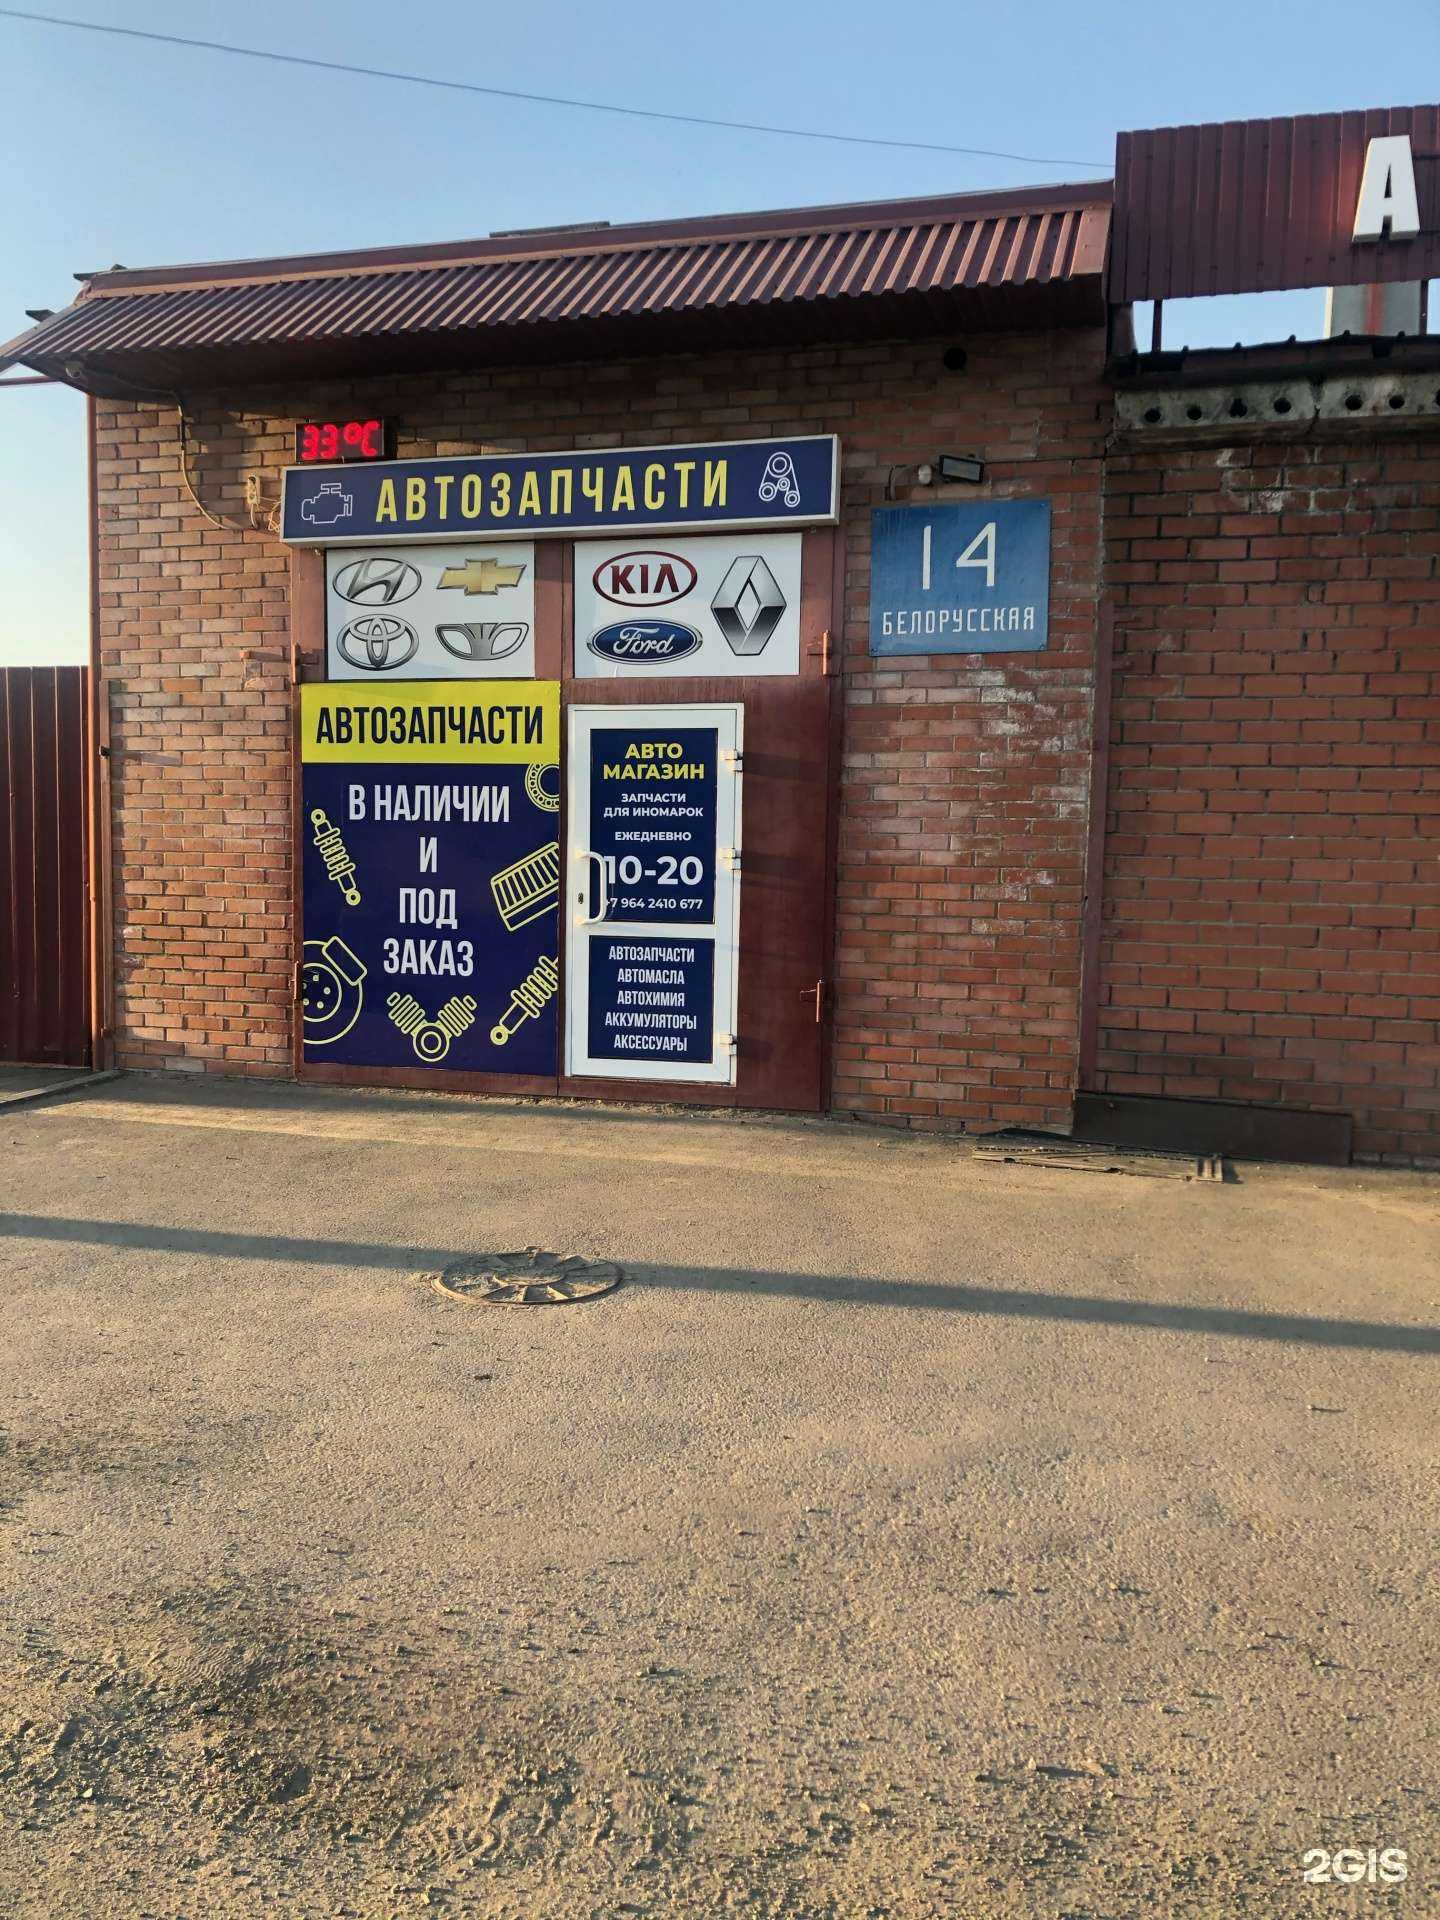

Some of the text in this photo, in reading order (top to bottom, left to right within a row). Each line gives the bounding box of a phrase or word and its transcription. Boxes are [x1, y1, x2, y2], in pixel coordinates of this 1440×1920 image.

[375, 460, 728, 523] АВТОЗАПЧАСТИ
[922, 522, 996, 590] 14
[611, 563, 679, 594] KIA
[882, 606, 1035, 635] БЕЛОРУССКАЯ
[613, 627, 675, 654] Ford
[316, 706, 544, 745] АВТОЗАПЧАСТИ
[625, 743, 683, 759] АВТО
[603, 763, 705, 780] МАГАЗИН
[348, 785, 510, 823] В НАЛИЧИИ
[621, 793, 687, 803] ЗАПЧАСТИ
[603, 807, 704, 818] ДЛЯ ИНОМАРОК
[614, 831, 692, 843] ЕЖЕДНЕВНО
[419, 836, 438, 873] И
[603, 855, 704, 886] 10-20
[399, 888, 458, 930] ПОД
[620, 898, 646, 909] 964
[647, 898, 677, 909] 2410
[679, 898, 704, 910] 677
[383, 938, 474, 977] ЗАКАЗ
[608, 945, 696, 963] АВТОЗАПЧАСТИ
[617, 968, 686, 985] АВТОМАСЛА
[617, 990, 686, 1008] АВТОХИМИЯ
[604, 1011, 698, 1031] АККУМУЛЯТОРЫ
[613, 1034, 689, 1052] АКСЕССУАРЫ
